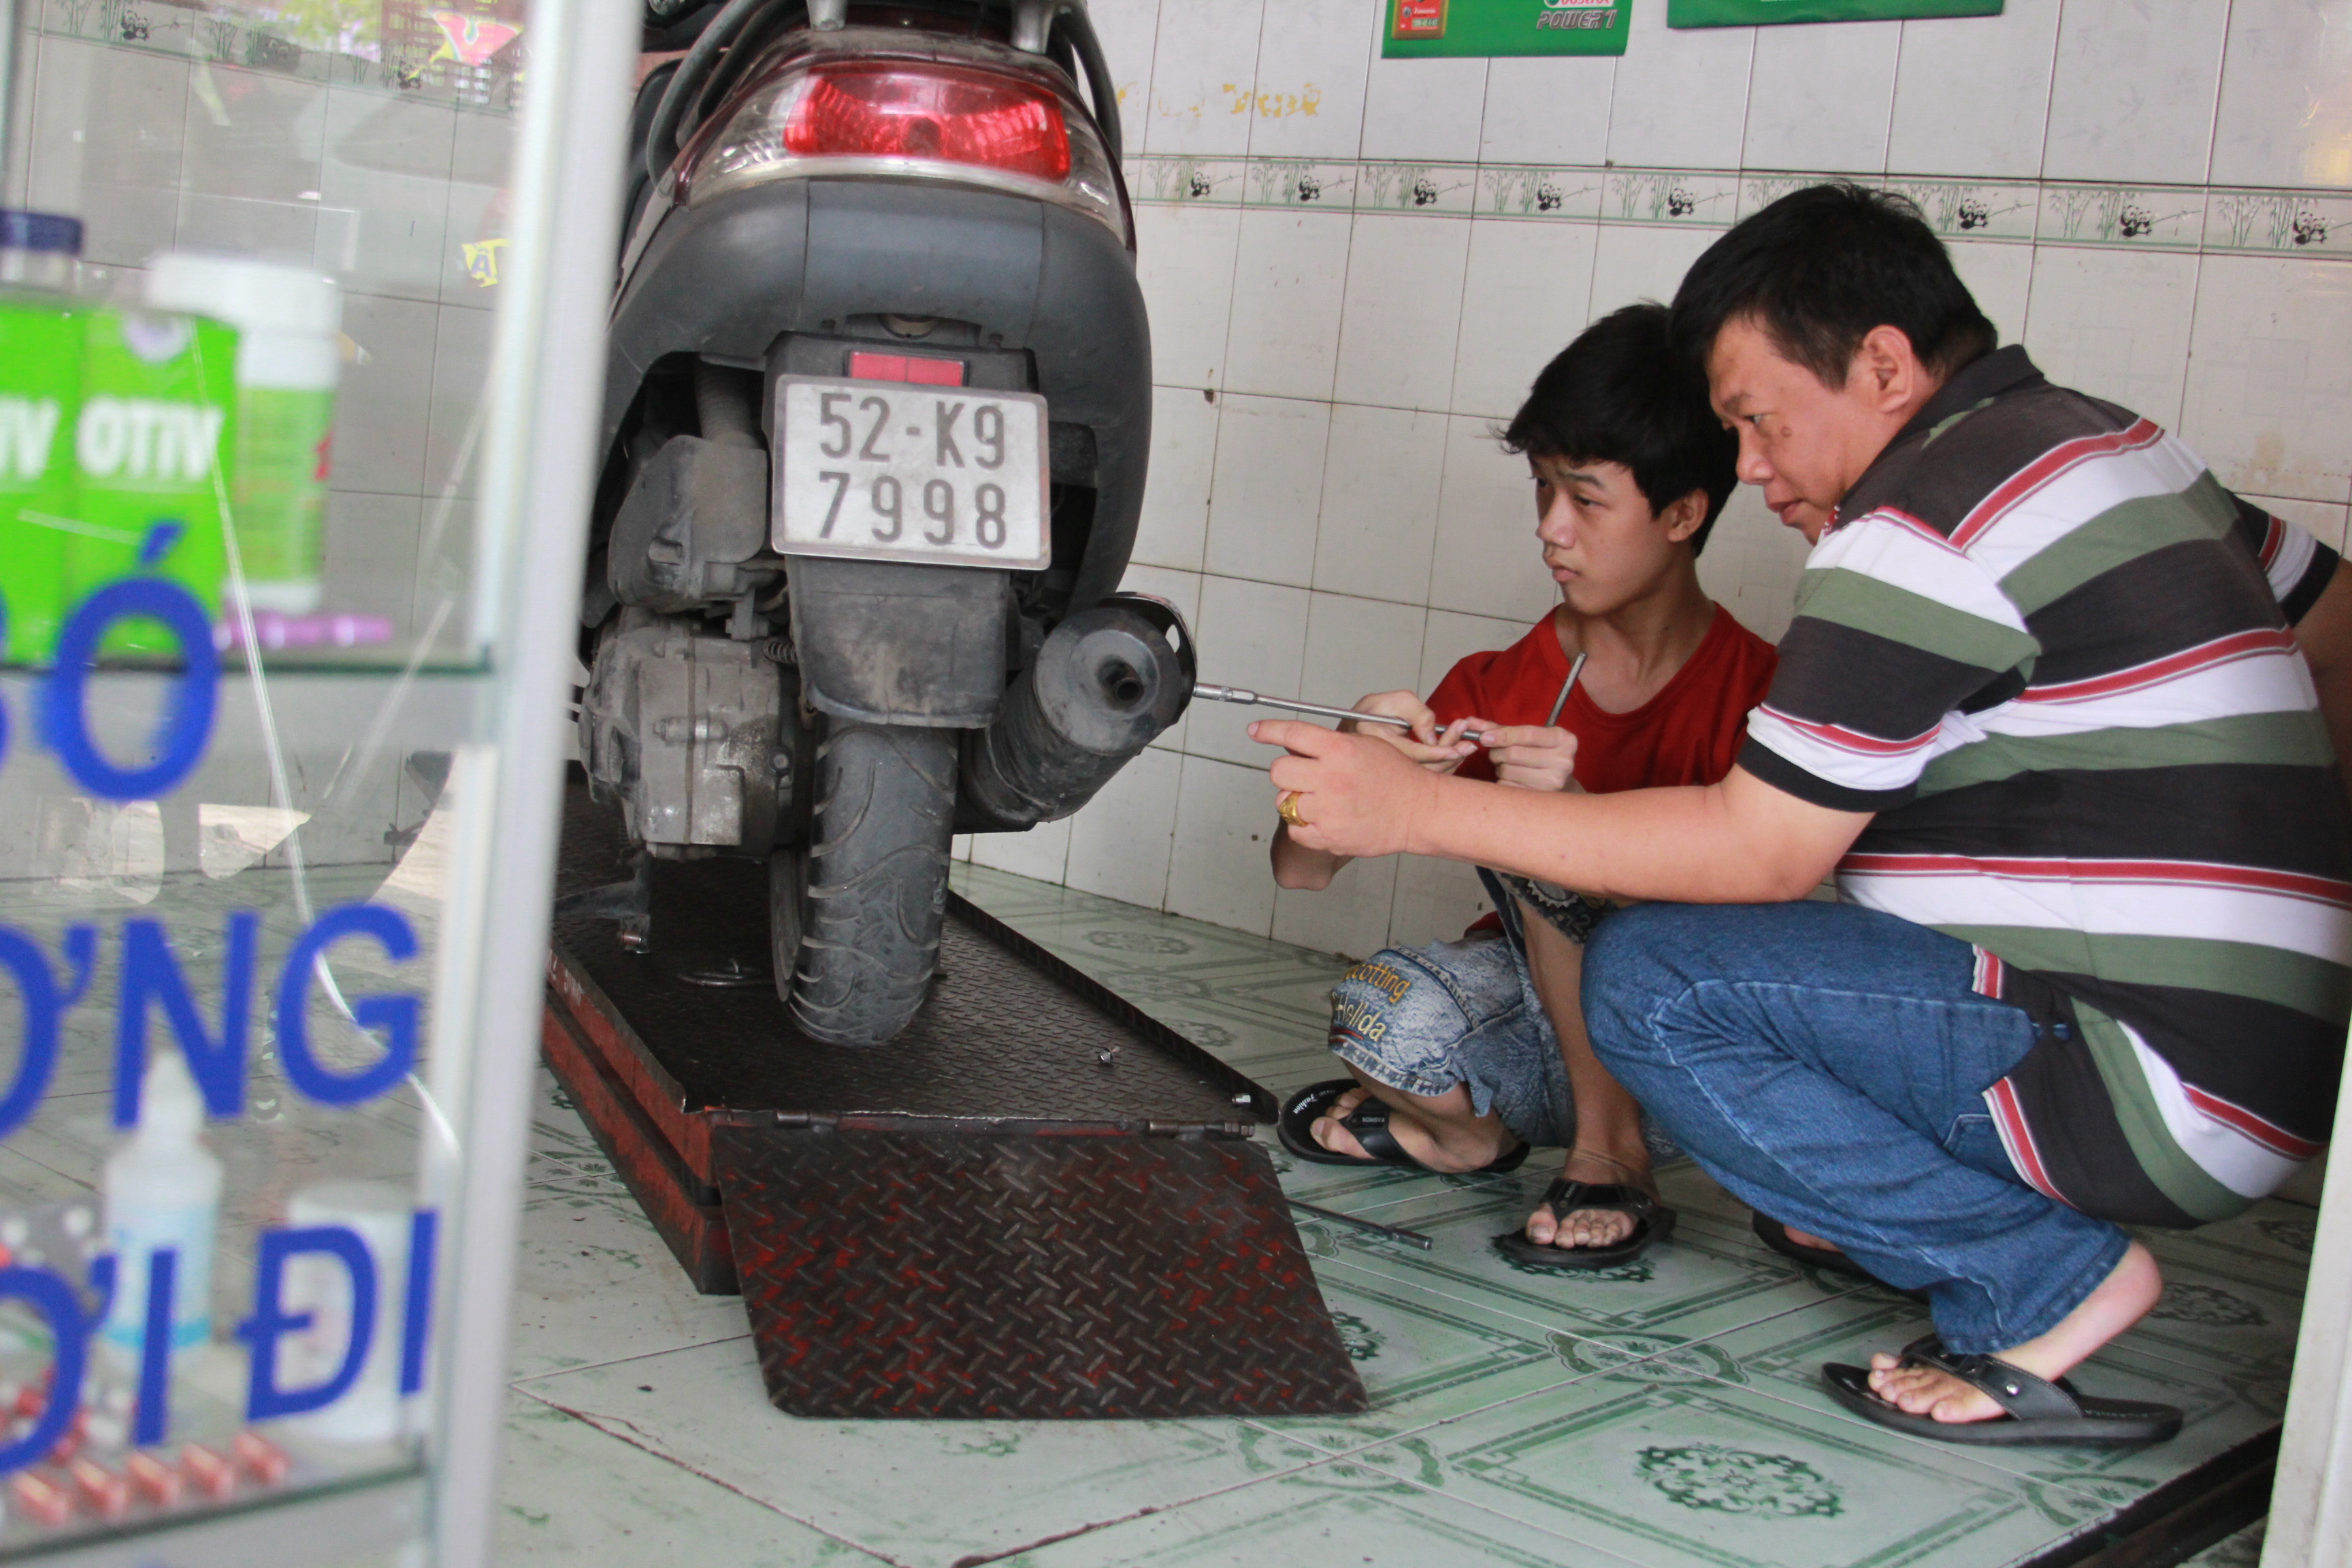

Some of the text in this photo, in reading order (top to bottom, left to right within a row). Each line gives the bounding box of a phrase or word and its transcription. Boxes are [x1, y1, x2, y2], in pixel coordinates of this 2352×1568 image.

[820, 393, 1005, 470] 52-K9
[819, 471, 1007, 550] 7998
[0, 519, 222, 803] Ó
[1293, 1094, 1318, 1114] Fashion
[235, 1206, 440, 1424] ĐI
